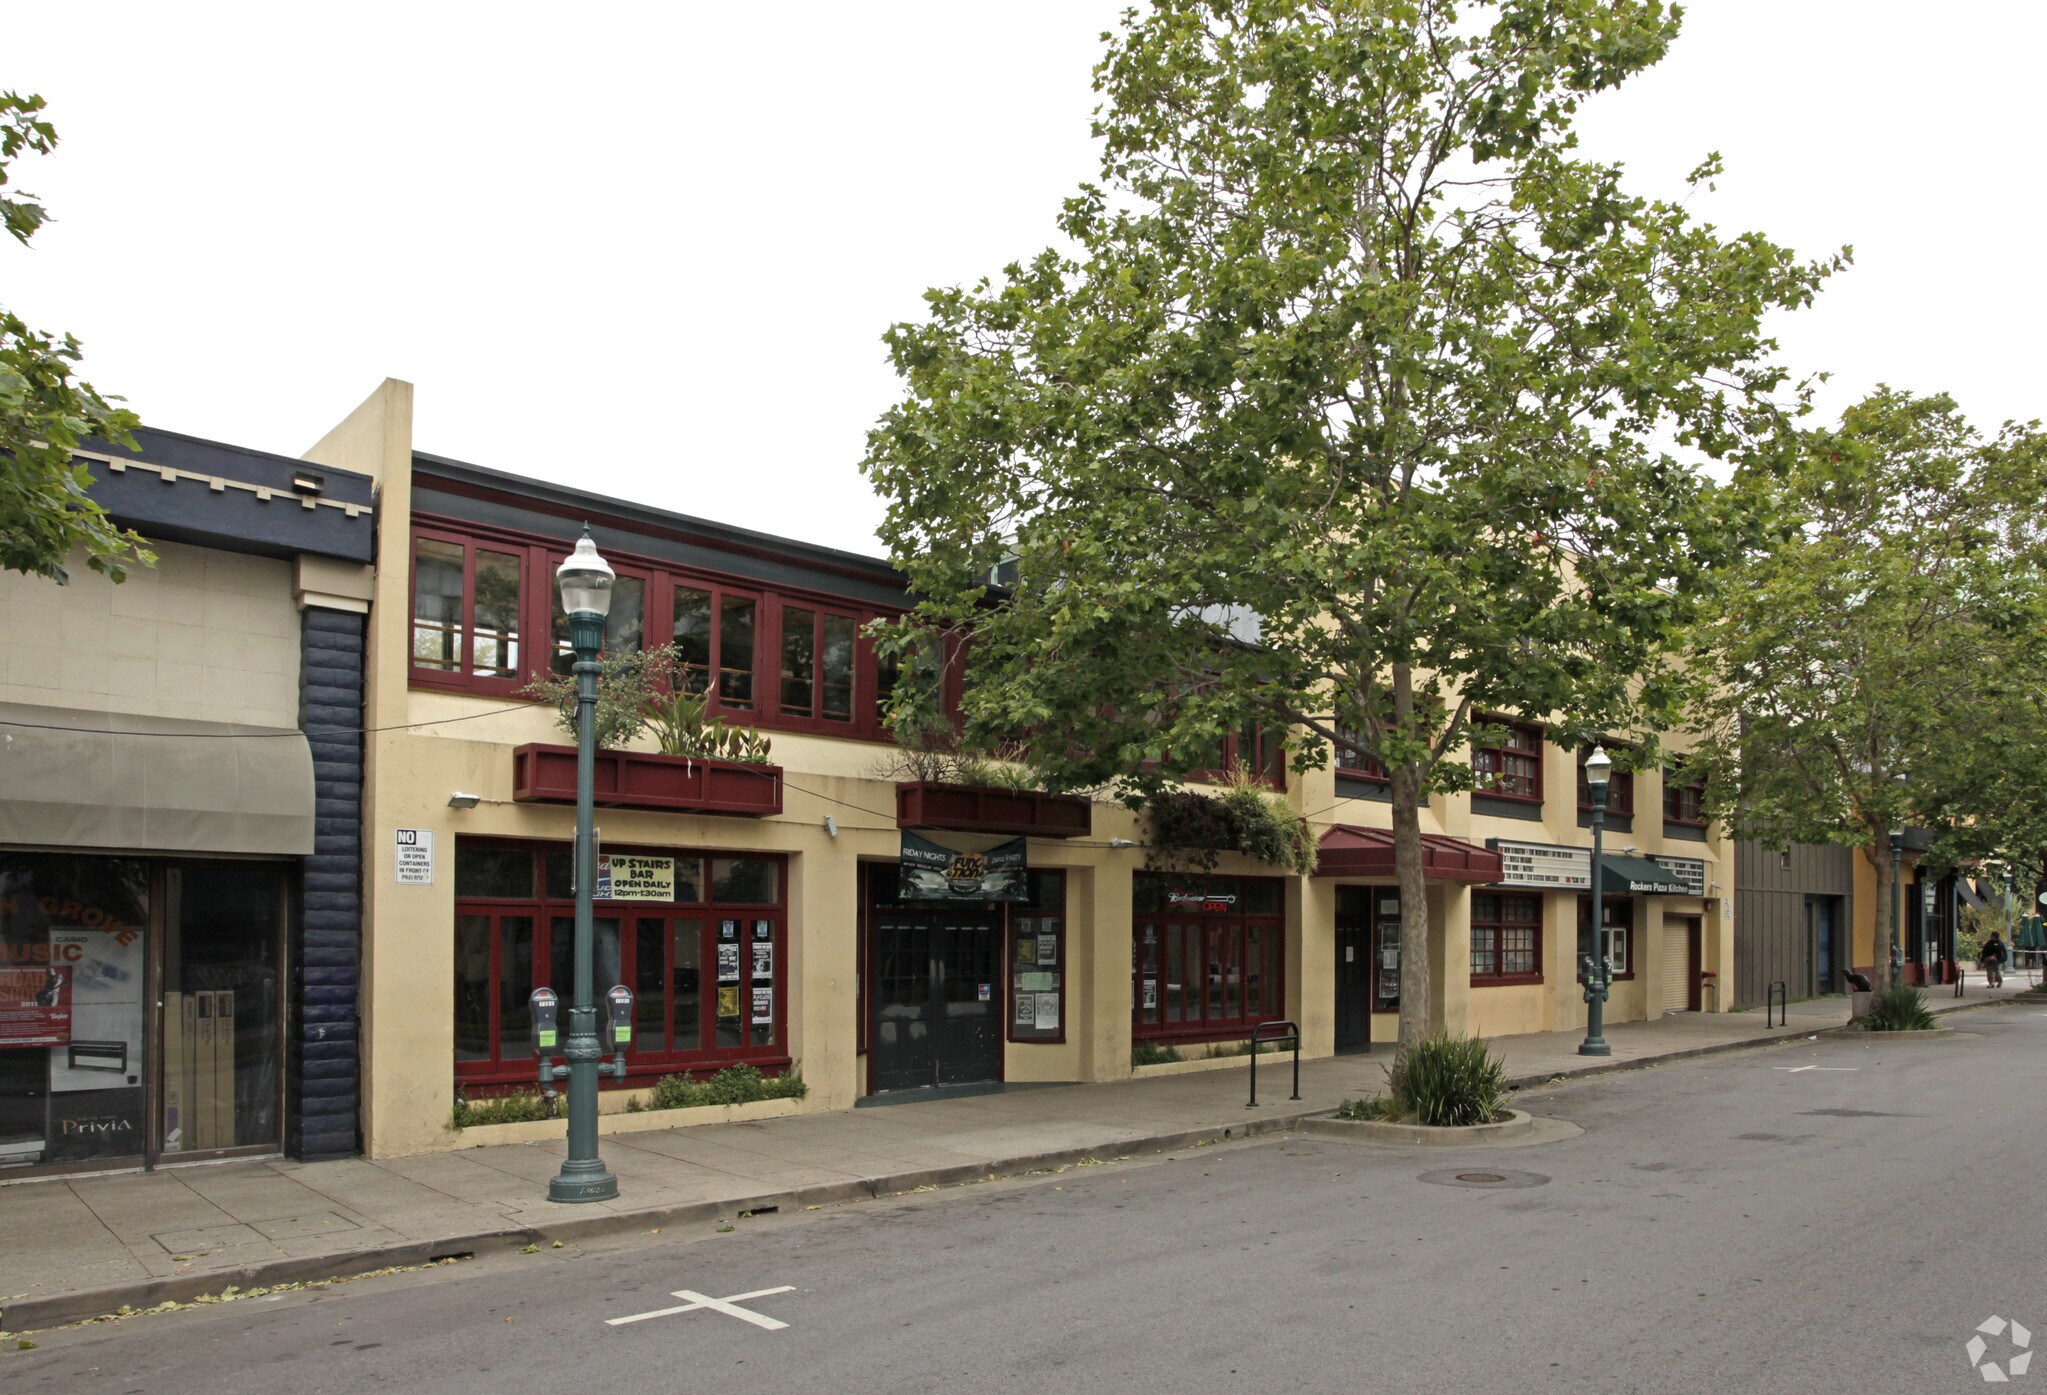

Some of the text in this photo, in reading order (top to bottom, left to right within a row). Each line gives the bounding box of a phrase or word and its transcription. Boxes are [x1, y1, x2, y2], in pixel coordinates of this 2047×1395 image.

[398, 831, 415, 844] NO
[903, 848, 946, 862] FRIDAY NIGHTS
[612, 858, 626, 868] UP
[628, 859, 671, 869] STAIRS
[630, 870, 654, 879] BAR
[614, 880, 671, 889] OPEN DAILY
[1630, 881, 1688, 893] Rockers Pizza Kitchen
[1203, 902, 1227, 912] OPEN
[38, 896, 139, 948] GROVE
